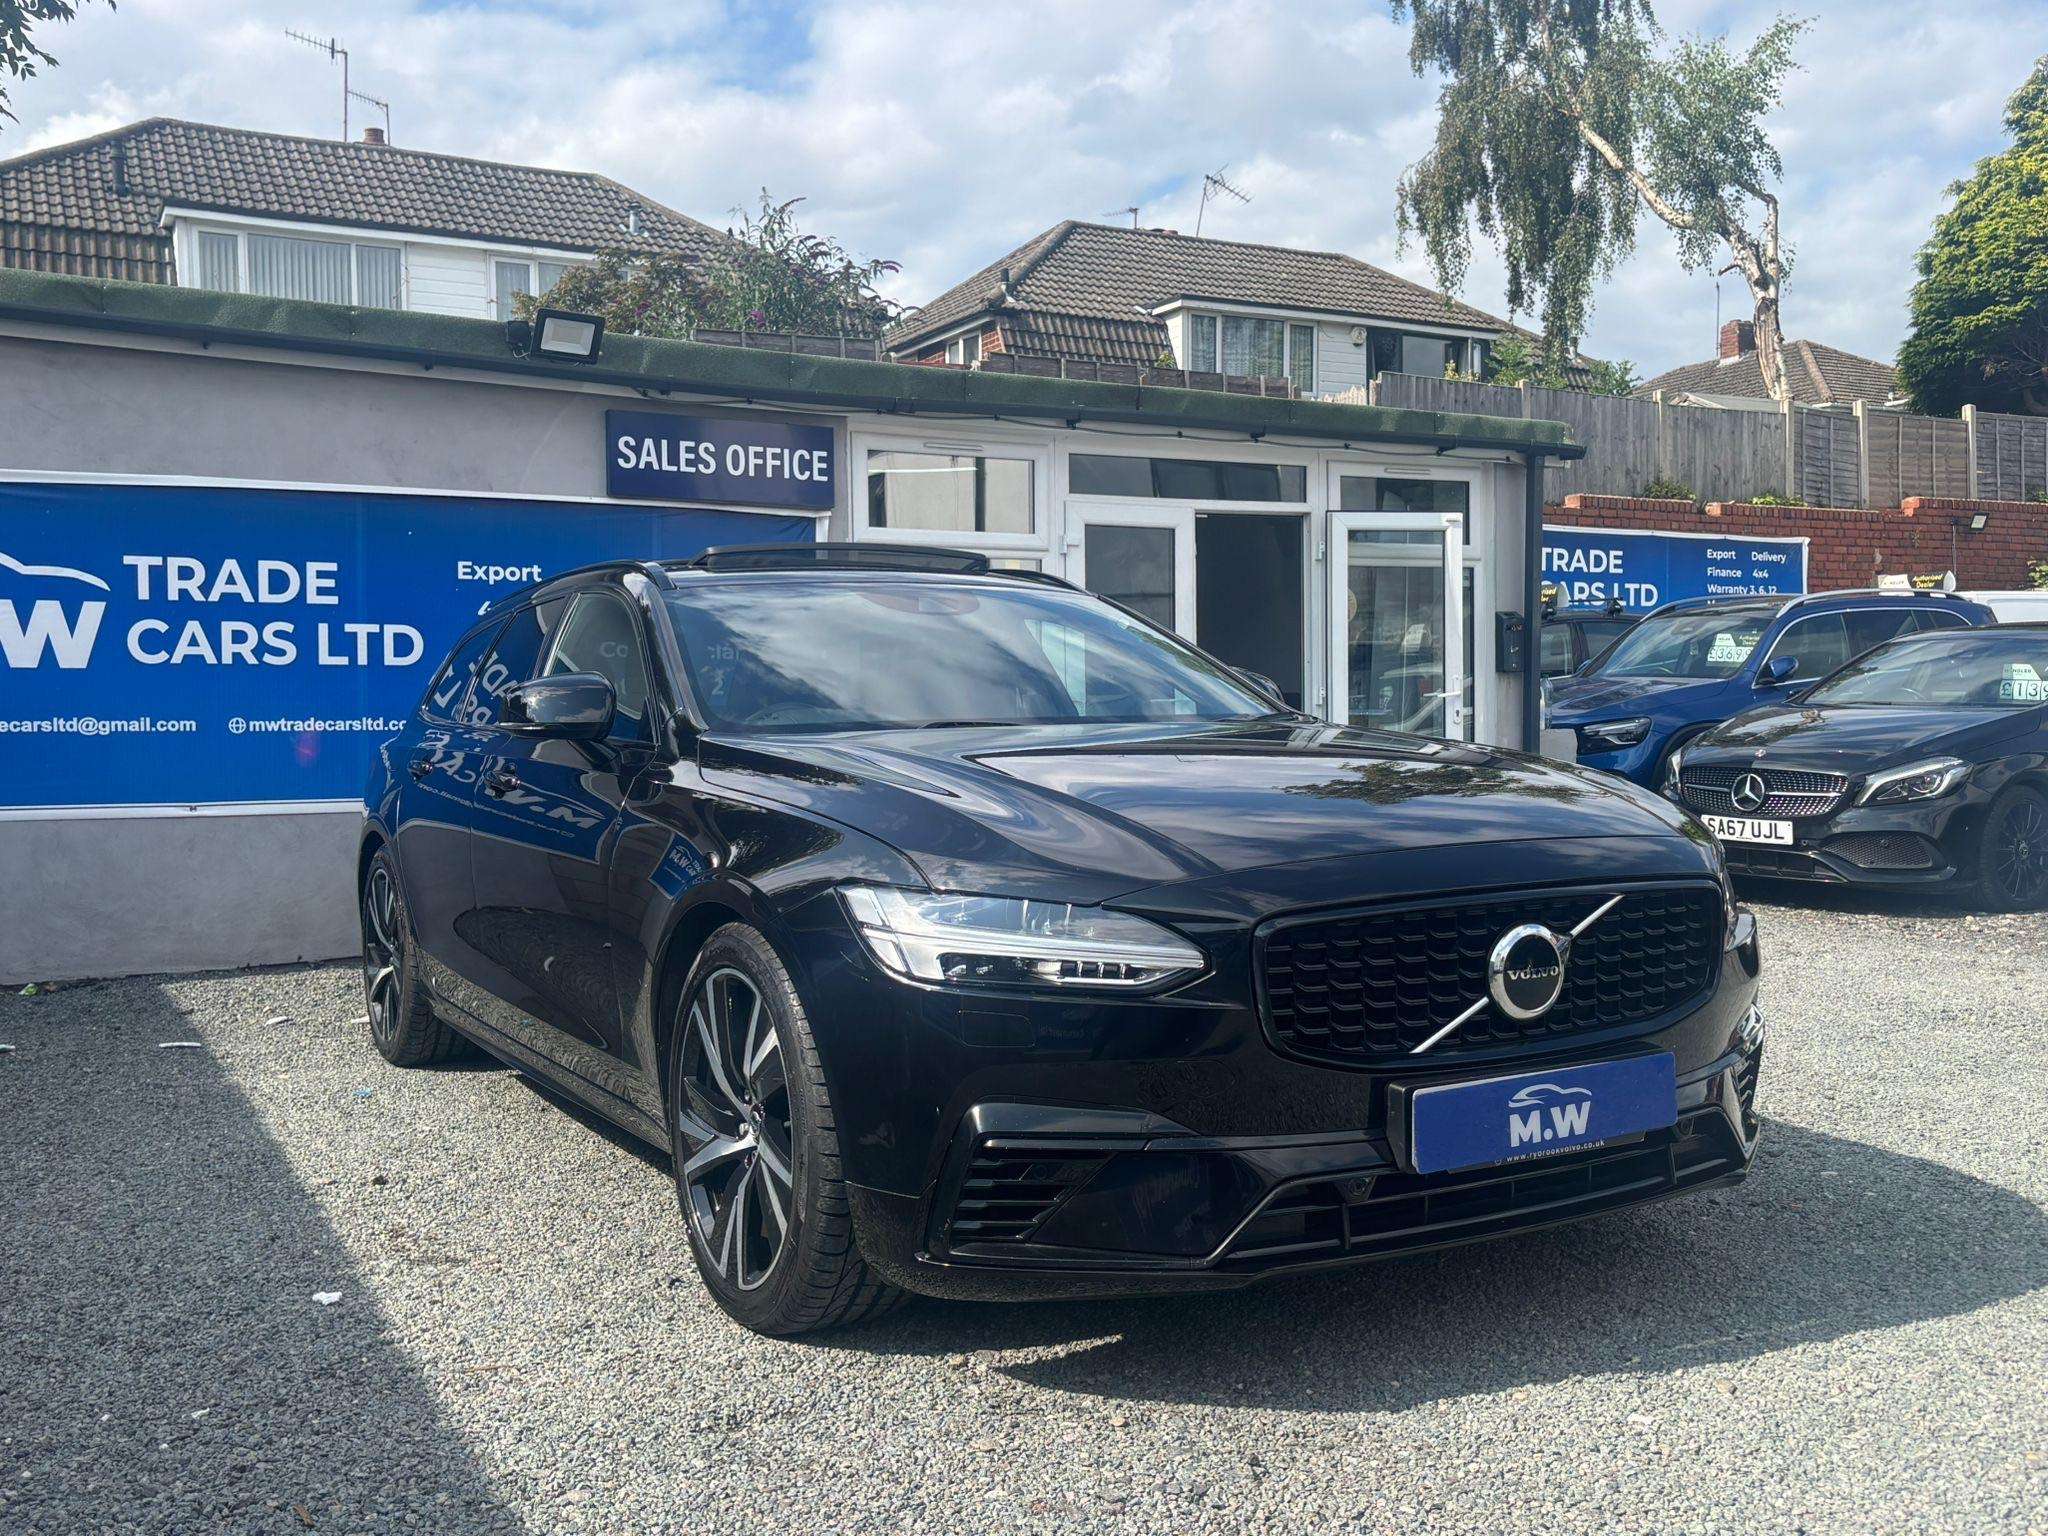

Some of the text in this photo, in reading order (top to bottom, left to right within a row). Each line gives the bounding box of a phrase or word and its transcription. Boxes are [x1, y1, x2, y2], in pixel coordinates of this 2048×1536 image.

[617, 435, 829, 482] SALES OFFICE
[1541, 547, 1624, 574] TRADE
[1706, 549, 1787, 564] Export Delivery
[123, 555, 339, 604] TRADE
[457, 561, 542, 585] Export
[1707, 566, 1769, 578] Finance 4x4
[1613, 582, 1659, 607] LTD
[1707, 584, 1748, 595] Warranty
[127, 619, 424, 667] CARS LTD
[1707, 817, 1785, 840] SA67 UJL
[1506, 965, 1559, 980] VOLVO
[1508, 1101, 1592, 1147] M.W
